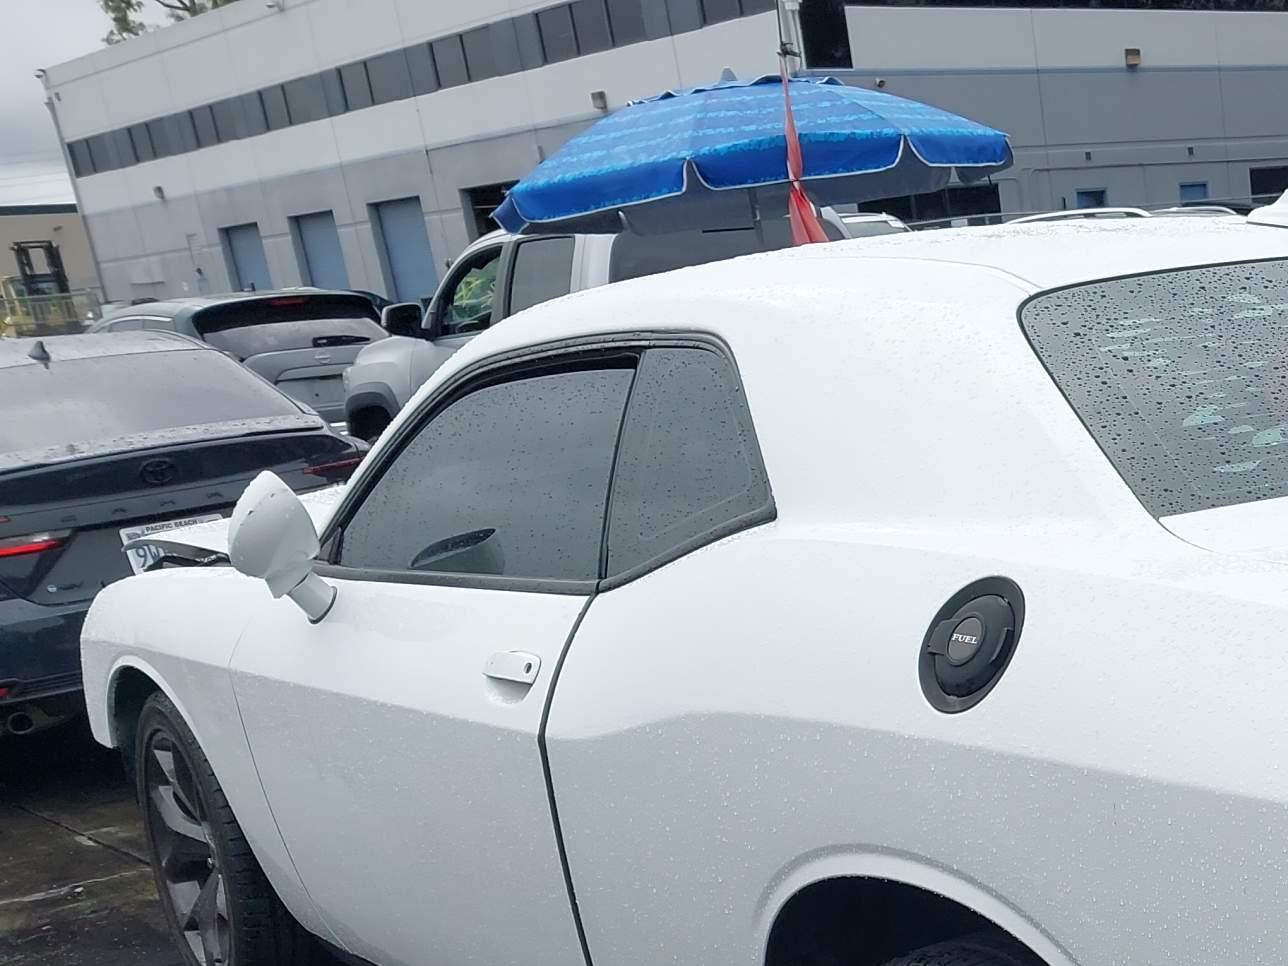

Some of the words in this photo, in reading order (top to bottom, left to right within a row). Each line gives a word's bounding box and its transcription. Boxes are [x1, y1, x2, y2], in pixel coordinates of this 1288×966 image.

[145, 522, 174, 533] PACIFIC
[174, 518, 198, 528] BEACH
[952, 633, 978, 644] FUEL
